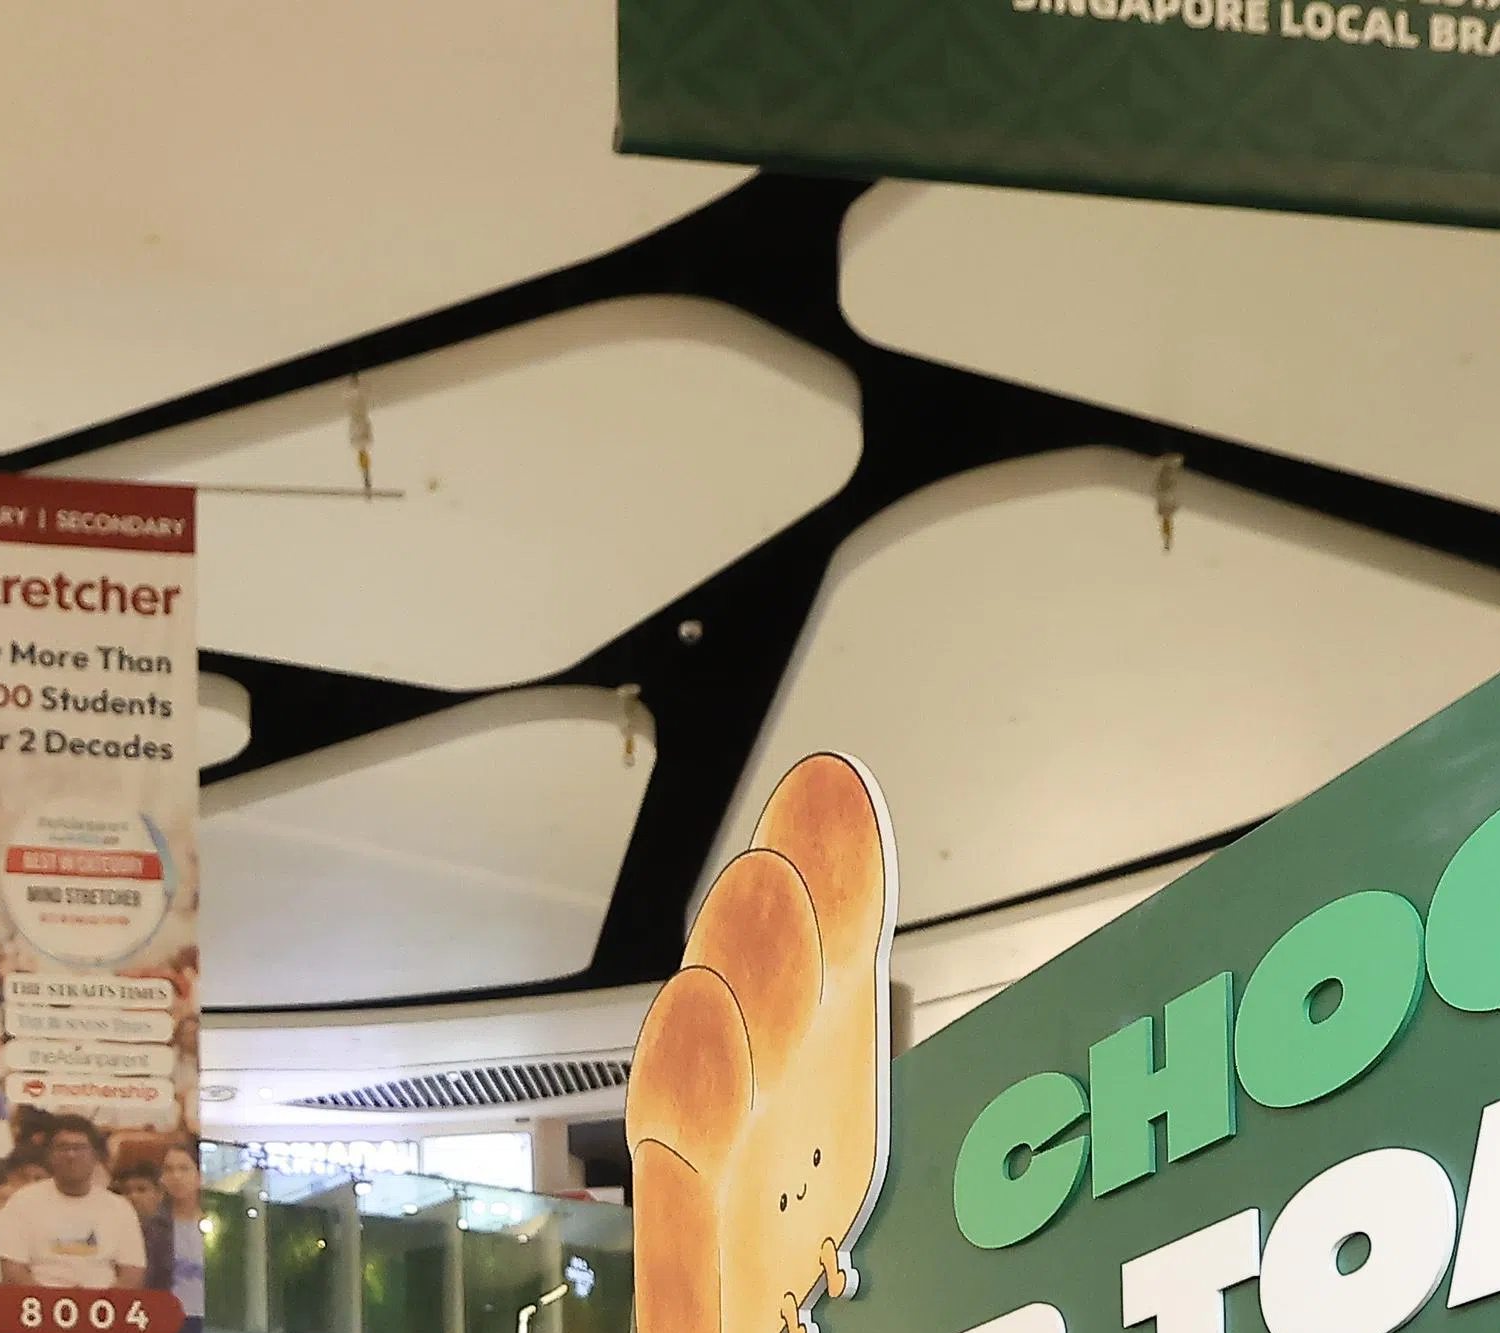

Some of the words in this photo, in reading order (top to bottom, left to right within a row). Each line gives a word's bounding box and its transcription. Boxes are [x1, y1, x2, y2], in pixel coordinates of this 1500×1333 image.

[1280, 0, 1421, 49] LOCAL
[56, 508, 187, 538] SECONDARY
[10, 641, 90, 671] More
[96, 645, 173, 676] Than
[42, 685, 174, 720] Students
[19, 726, 36, 754] 2
[45, 730, 174, 762] Decades
[21, 1297, 151, 1332] 8004
